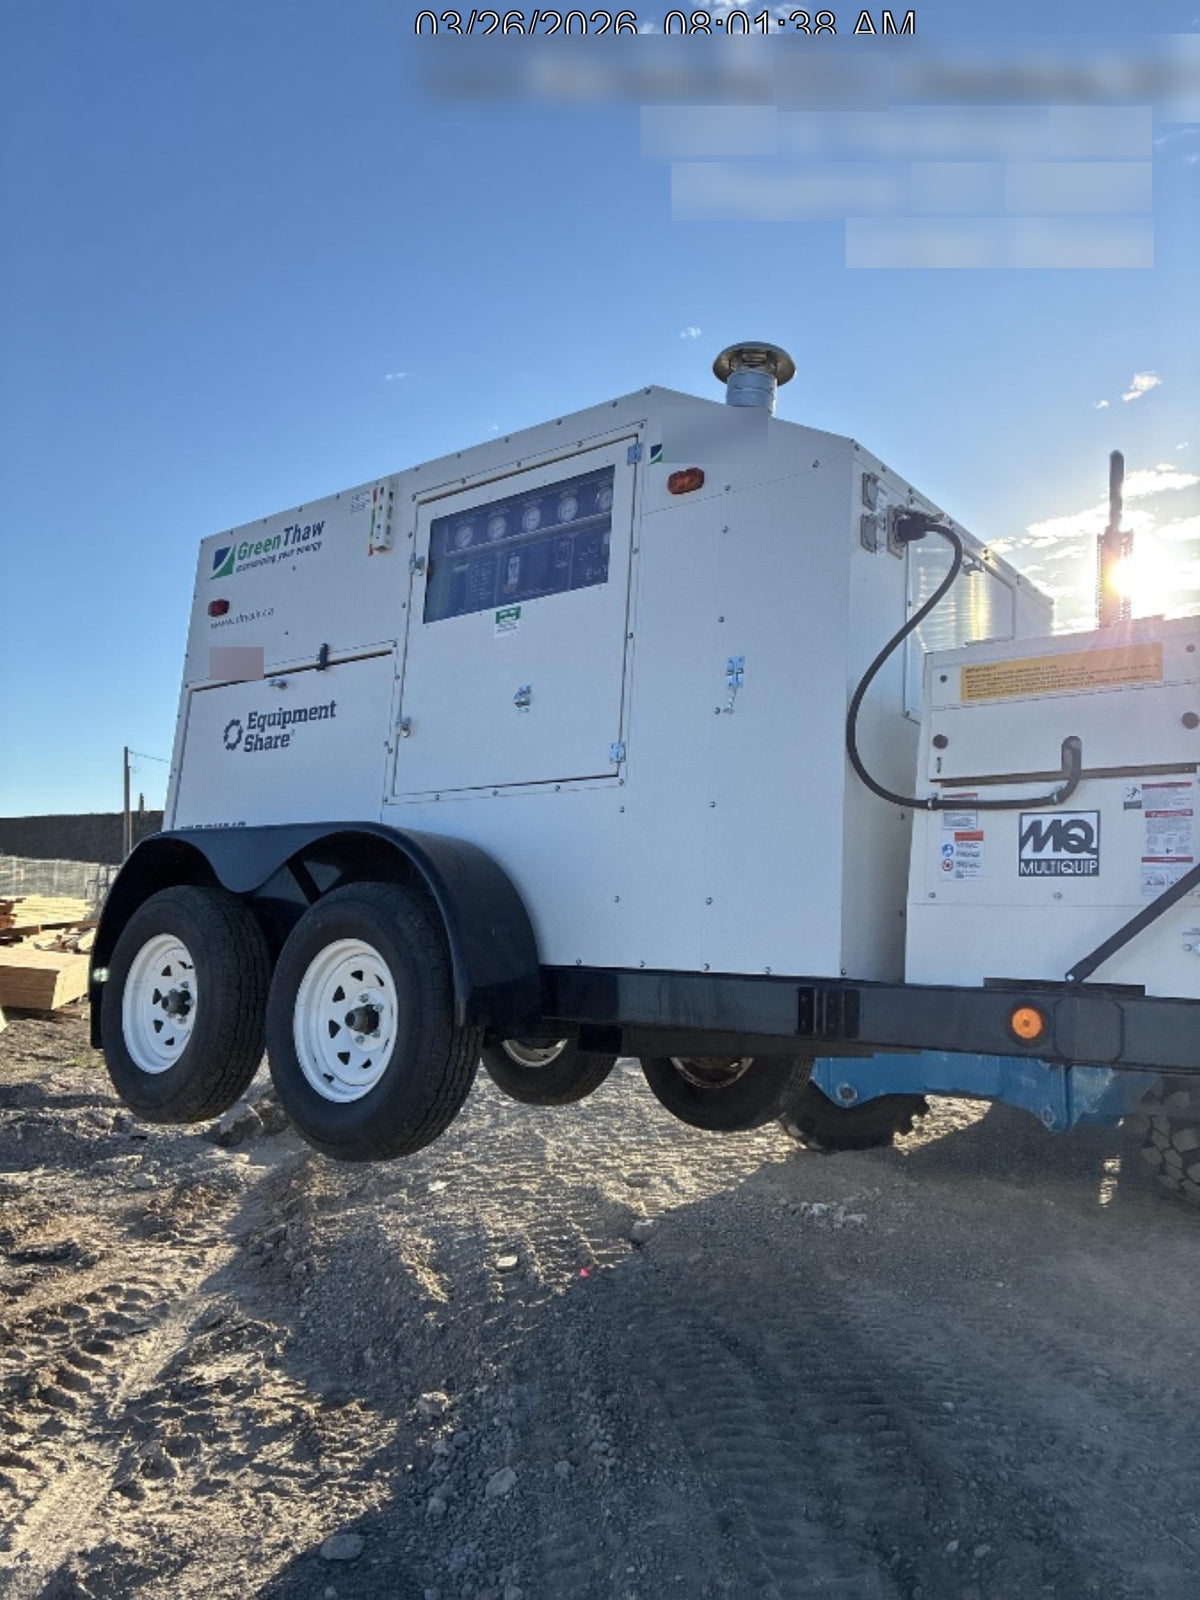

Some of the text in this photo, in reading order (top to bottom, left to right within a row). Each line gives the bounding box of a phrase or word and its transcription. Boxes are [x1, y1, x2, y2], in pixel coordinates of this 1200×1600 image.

[246, 700, 337, 733] Equipment
[243, 733, 291, 752] Share
[1020, 819, 1098, 854] MQ
[1020, 860, 1098, 874] MULTIQUIP
